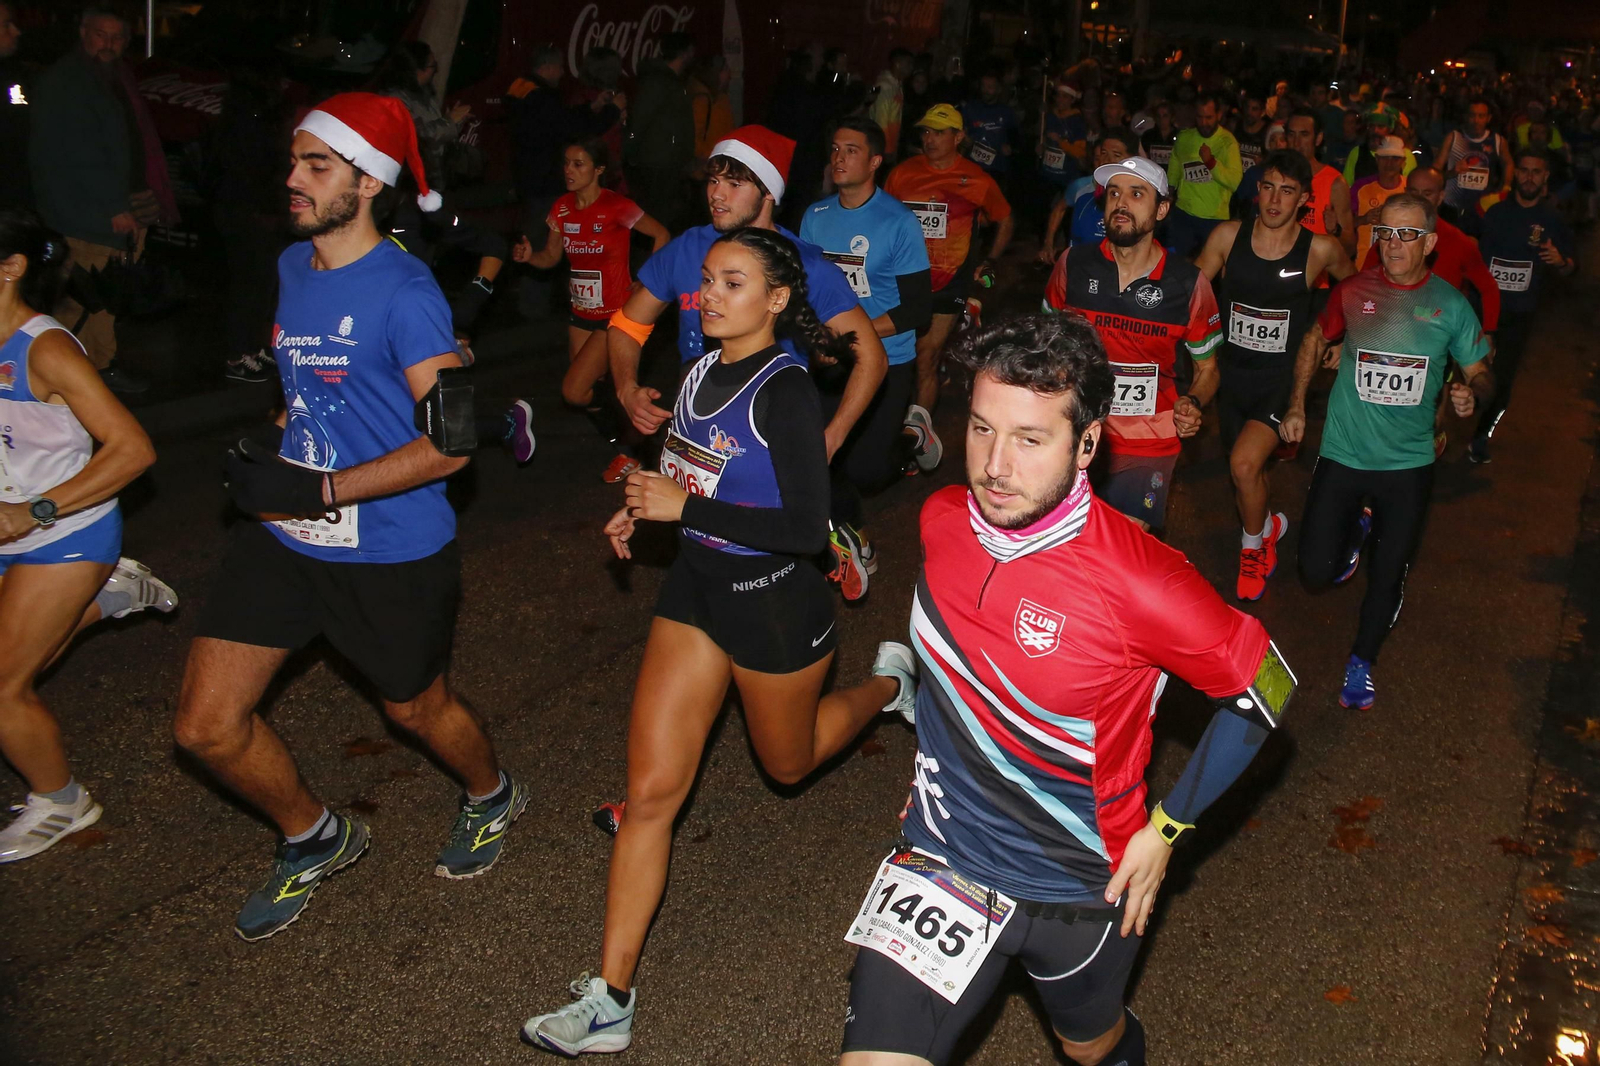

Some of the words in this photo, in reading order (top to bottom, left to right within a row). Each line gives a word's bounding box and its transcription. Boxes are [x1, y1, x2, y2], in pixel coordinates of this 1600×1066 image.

[1188, 169, 1209, 179] 1115
[1462, 174, 1484, 183] 1547
[1494, 270, 1526, 283] 2302
[1095, 315, 1168, 337] ARCHIDONA
[1236, 320, 1280, 341] 1184
[276, 329, 322, 350] Carrera
[1107, 329, 1145, 346] RUNNING
[288, 348, 351, 367] Nocturna
[314, 368, 349, 377] Granada
[1363, 370, 1414, 392] 1701
[1117, 384, 1147, 401] 73
[732, 576, 770, 592] NIKE
[771, 561, 796, 583] PRO
[1020, 609, 1058, 633] CLUB
[951, 881, 965, 892] Paseo
[964, 889, 973, 897] del
[952, 873, 969, 889] Viernes,
[876, 882, 974, 957] 1465
[869, 916, 880, 926] PABLO
[879, 918, 905, 937] CABALLERO
[902, 932, 930, 955] GONZALEZ
[927, 949, 946, 967] (1990)
[965, 947, 980, 968] ABSOLUTA
